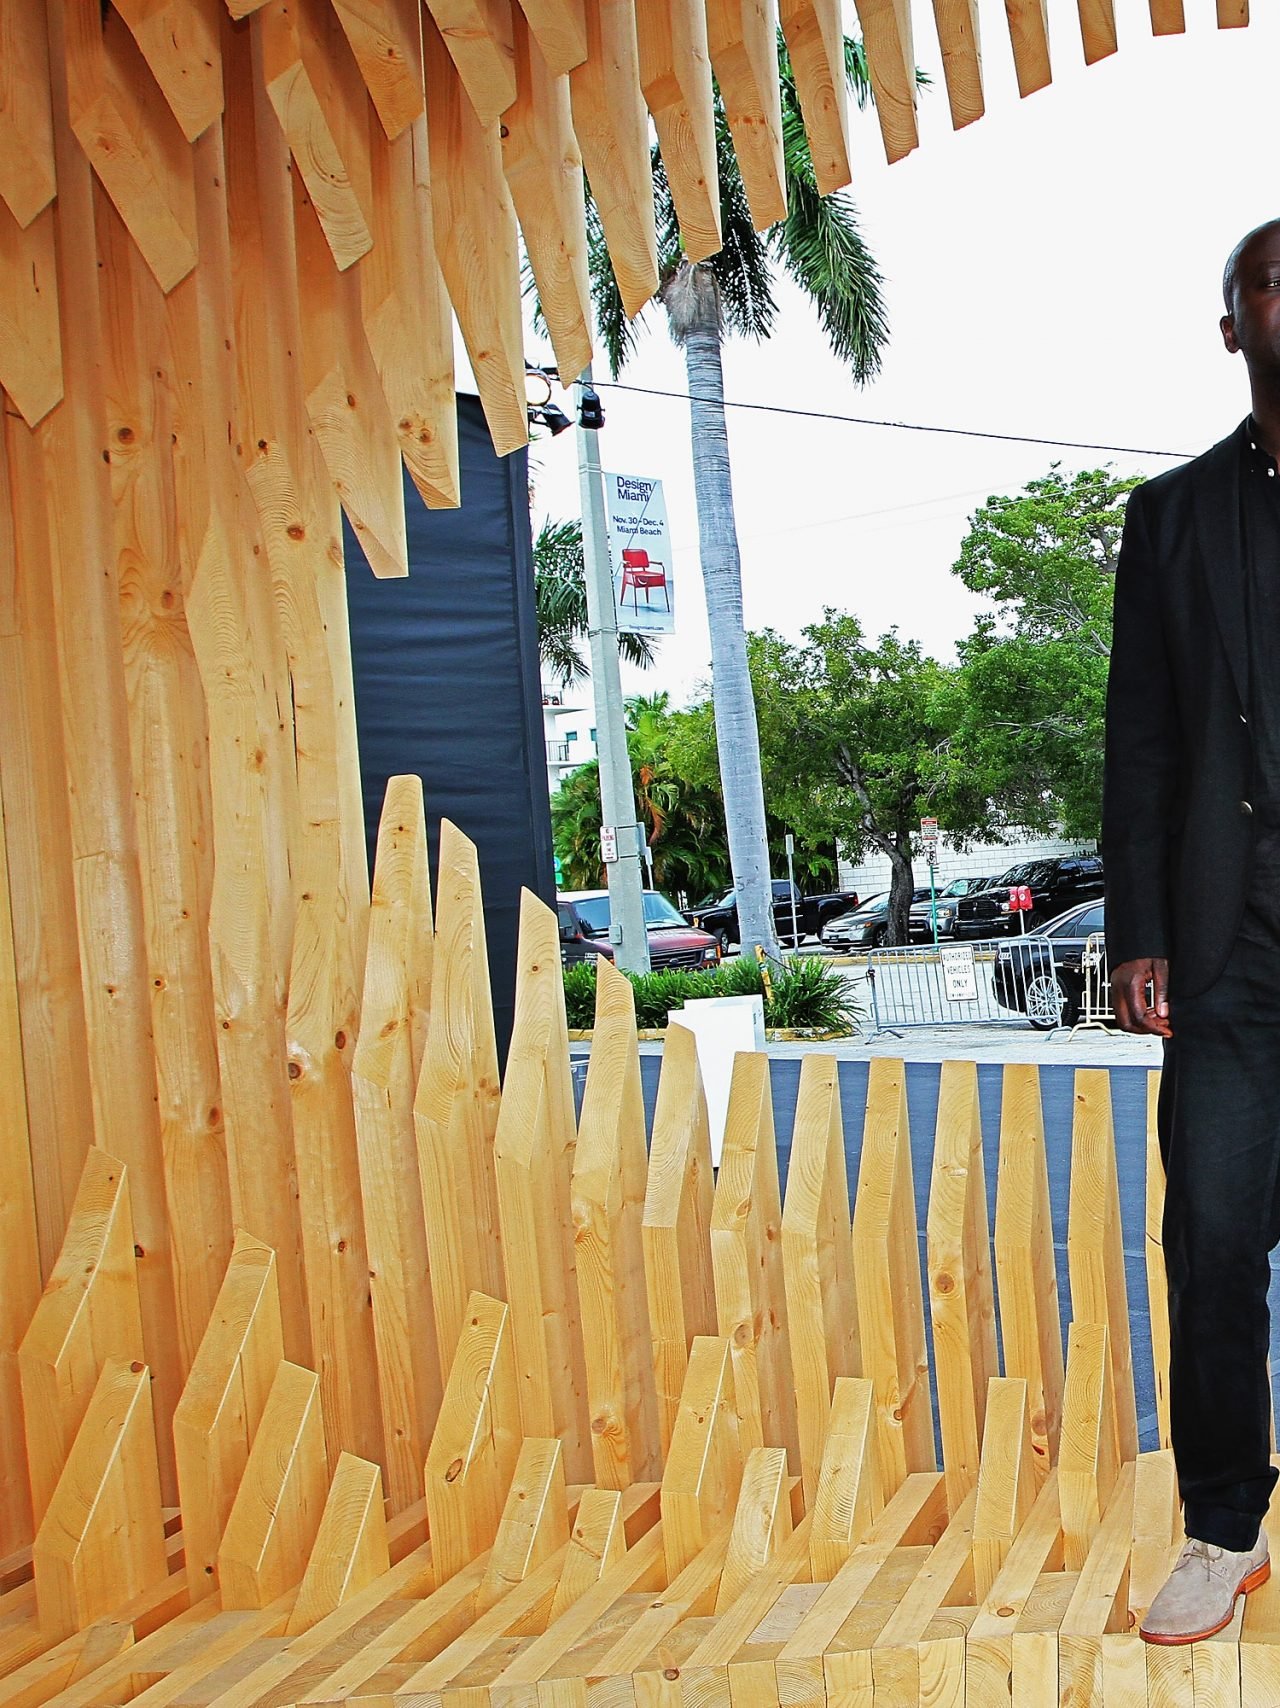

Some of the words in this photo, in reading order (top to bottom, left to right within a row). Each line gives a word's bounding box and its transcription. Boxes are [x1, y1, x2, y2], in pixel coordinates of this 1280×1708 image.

[617, 476, 652, 493] Design
[618, 488, 649, 502] Miami
[613, 515, 627, 524] Nov.
[628, 516, 637, 524] 30
[643, 518, 658, 526] Dec.
[617, 525, 638, 534] Miami
[640, 527, 662, 535] Beach
[943, 952, 971, 961] AUTHORIZED
[947, 965, 971, 974] VEHICLES
[953, 979, 968, 988] ONLY
